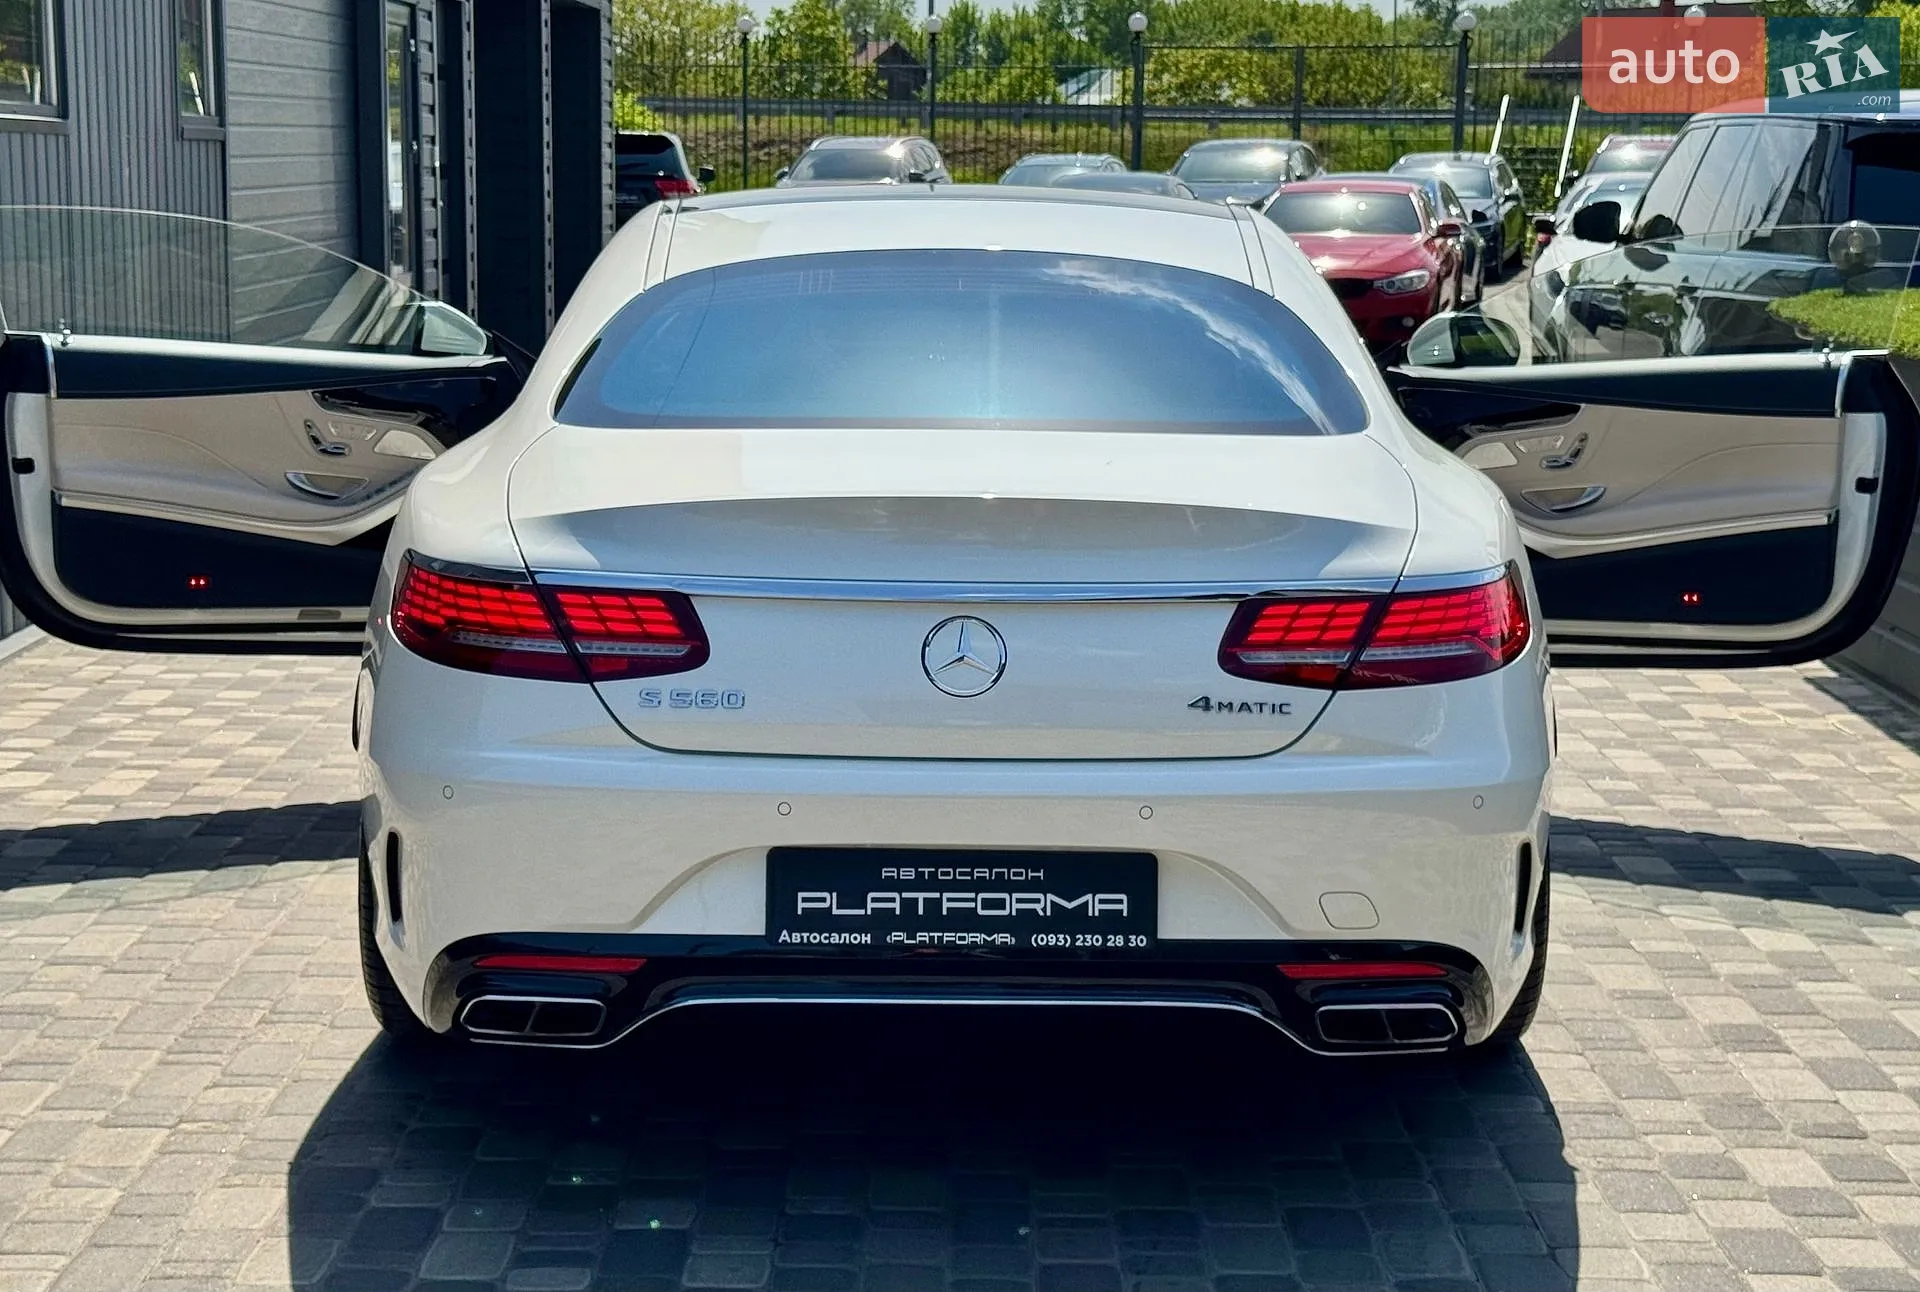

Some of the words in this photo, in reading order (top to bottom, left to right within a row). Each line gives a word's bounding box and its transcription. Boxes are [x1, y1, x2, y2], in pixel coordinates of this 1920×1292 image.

[639, 688, 661, 708] S
[669, 688, 745, 709] 560
[1187, 696, 1293, 715] 4MATIC
[881, 867, 1044, 881] АВТОСАЛОН
[797, 892, 1128, 917] PLATFORMA
[778, 930, 872, 945] Автосалон
[1031, 934, 1071, 948] (093)
[1075, 935, 1102, 947] 230
[1106, 936, 1124, 947] 28
[1128, 936, 1147, 948] 30
